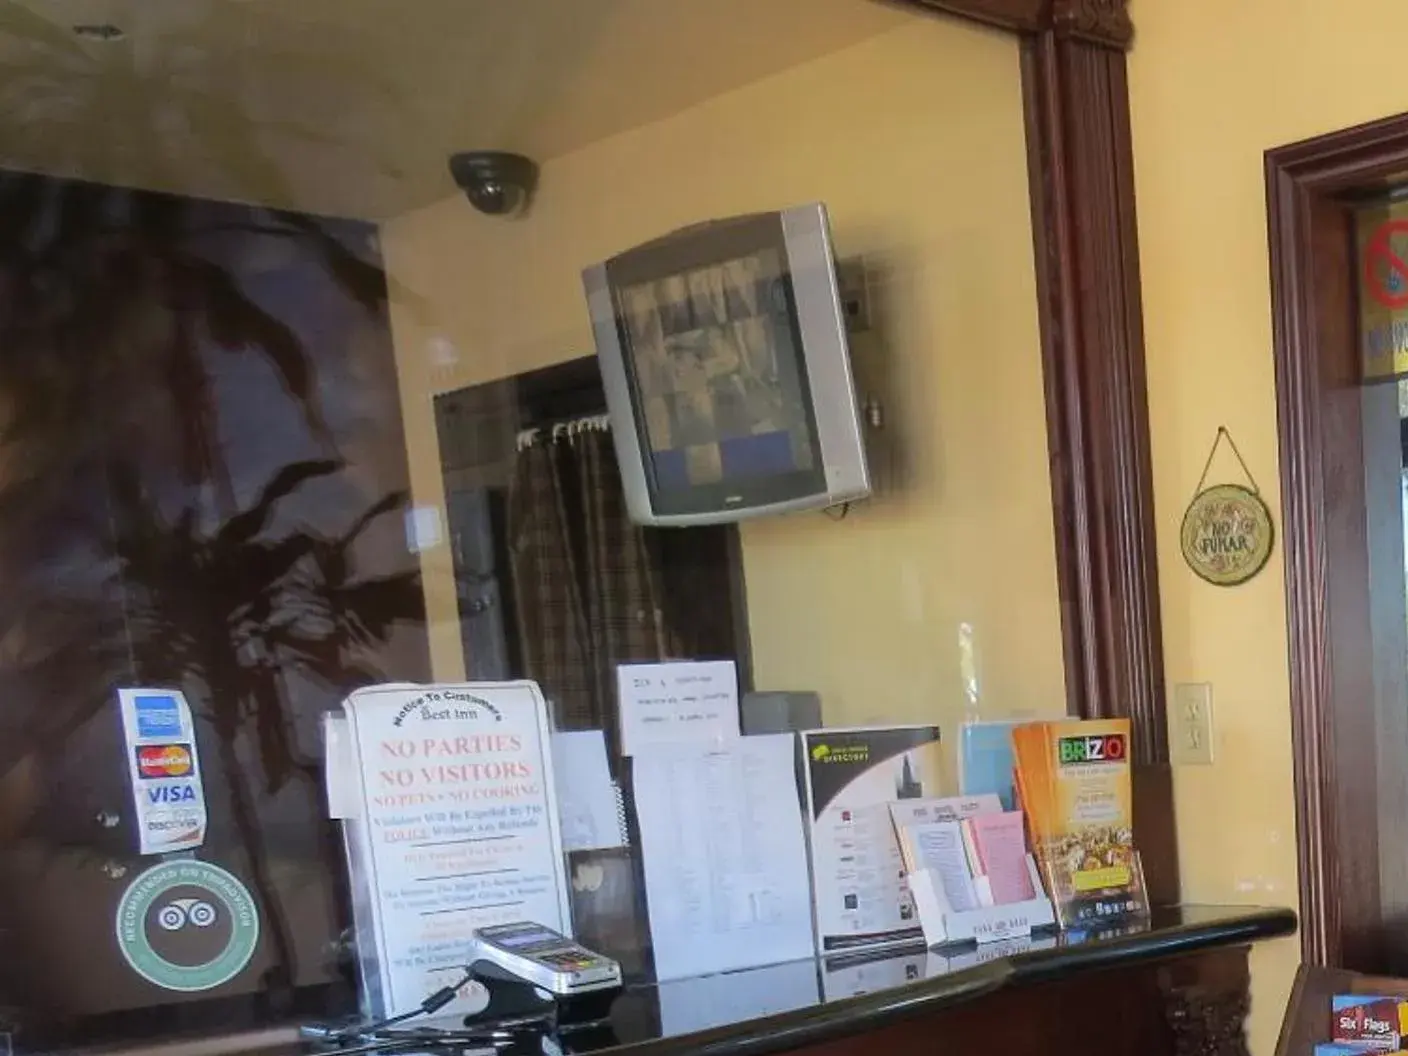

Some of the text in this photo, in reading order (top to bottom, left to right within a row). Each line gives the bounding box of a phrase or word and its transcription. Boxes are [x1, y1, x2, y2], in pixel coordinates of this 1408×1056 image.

[427, 692, 441, 702] To
[381, 734, 523, 758] NO PARTIES
[380, 761, 533, 787] NO VISITORS
[148, 785, 197, 803] VISA
[1339, 1016, 1391, 1034] Six Flags
